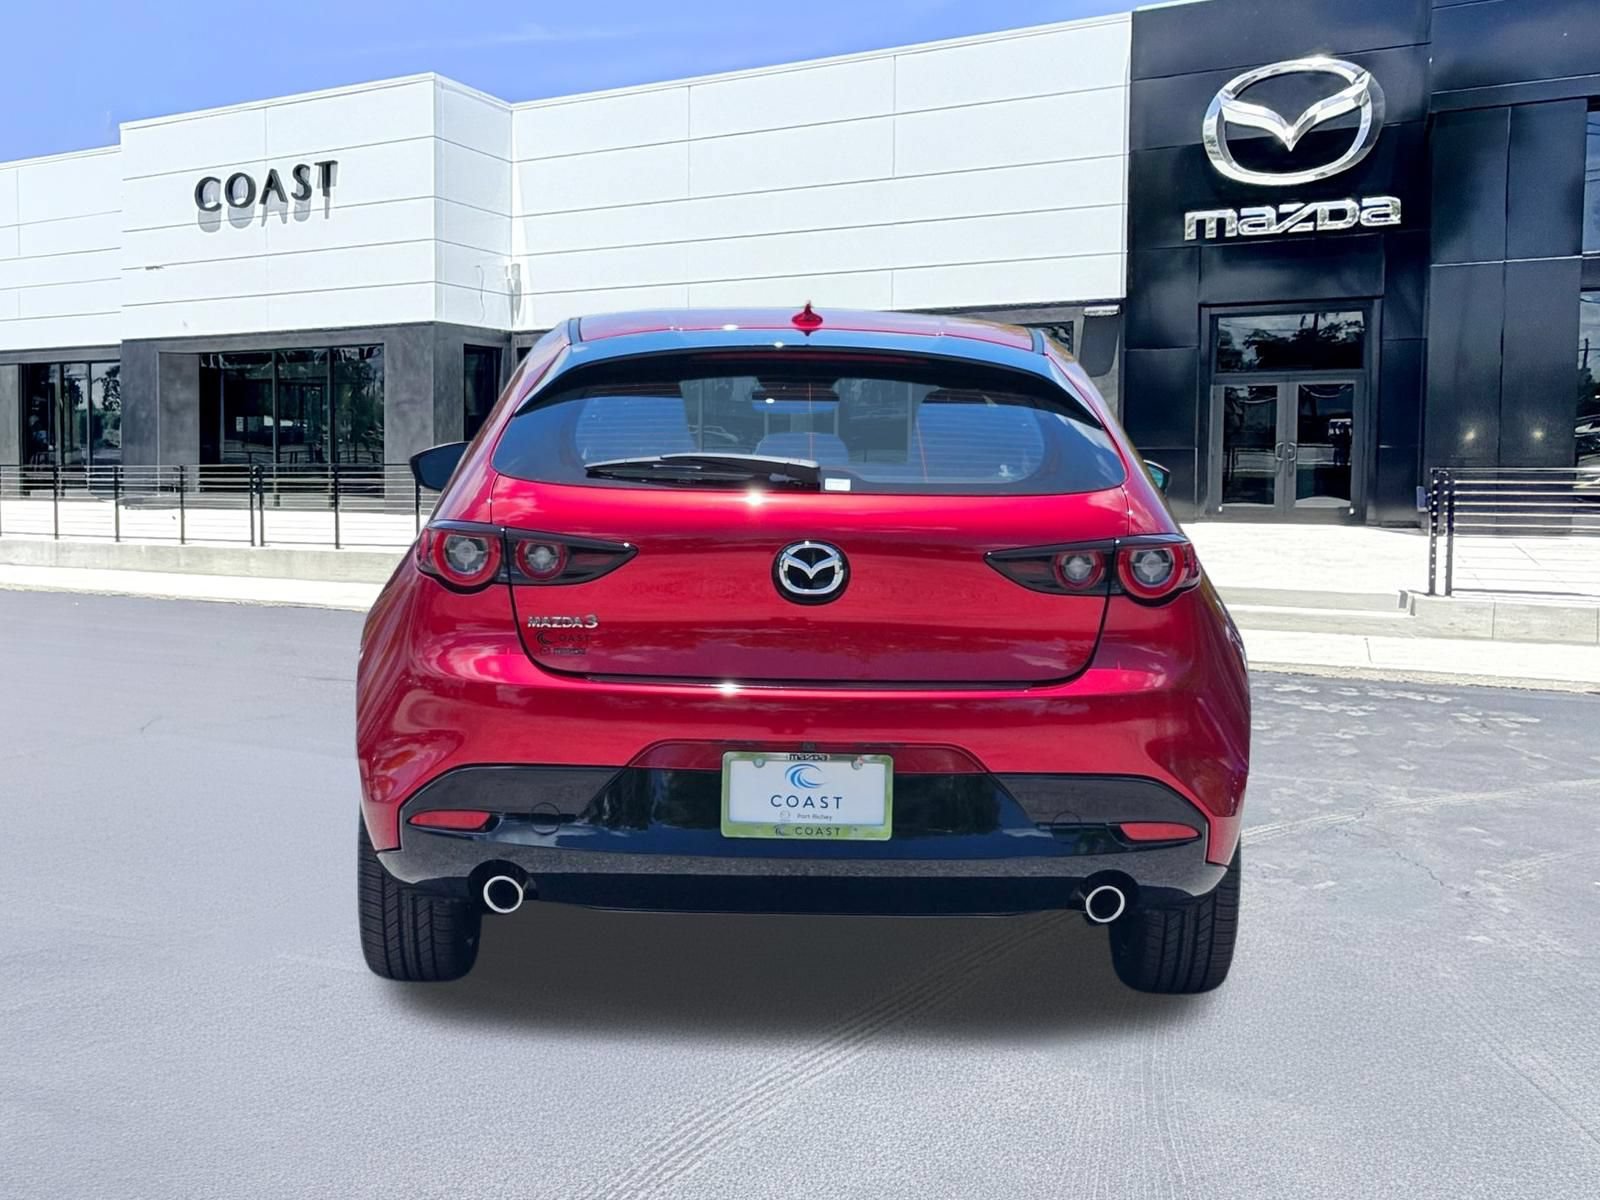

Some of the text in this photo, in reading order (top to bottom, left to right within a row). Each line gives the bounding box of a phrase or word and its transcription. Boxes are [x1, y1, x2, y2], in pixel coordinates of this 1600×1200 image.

[194, 159, 338, 212] COAST
[770, 794, 843, 809] COAST
[795, 826, 841, 837] COAST
